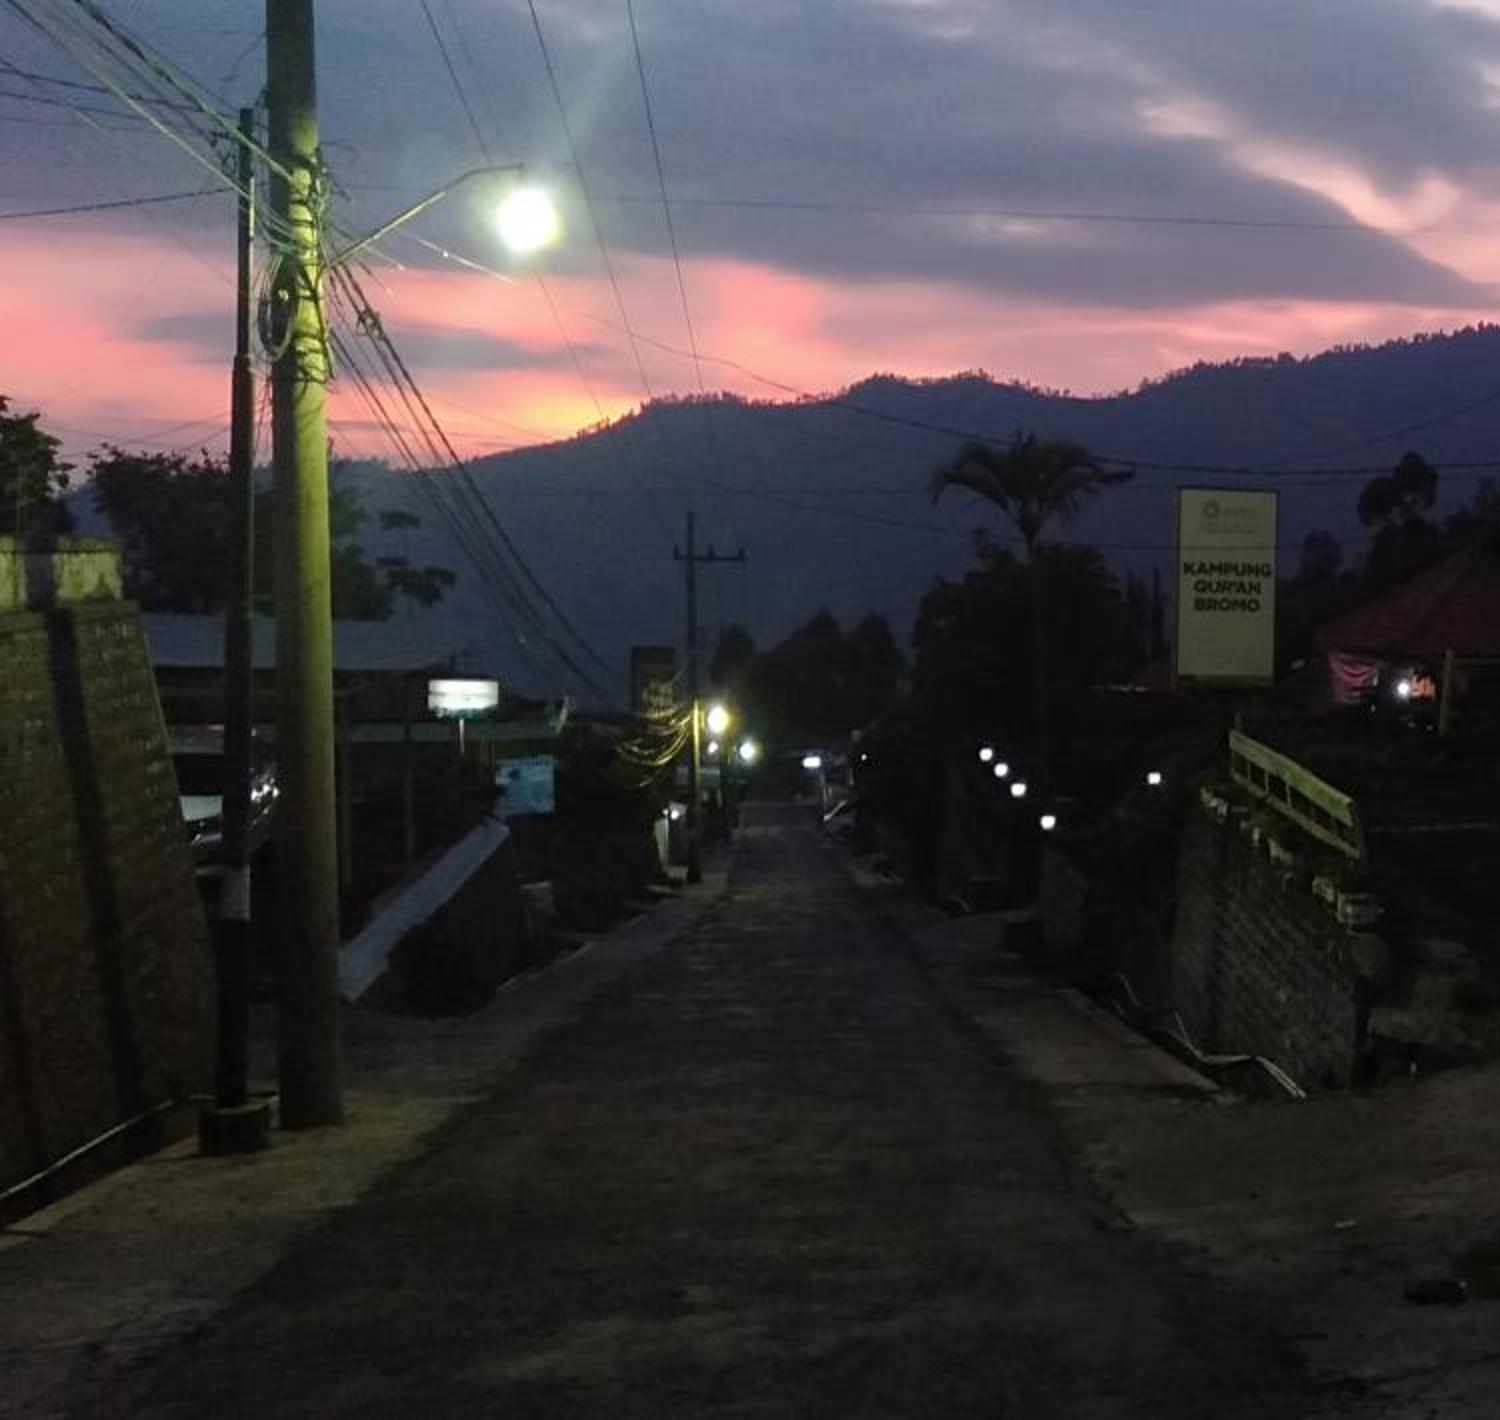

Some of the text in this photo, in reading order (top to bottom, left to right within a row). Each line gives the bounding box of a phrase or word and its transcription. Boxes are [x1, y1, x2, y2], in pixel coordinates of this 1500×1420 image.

[1183, 562, 1271, 577] KAMPUNG
[1194, 580, 1262, 595] QUR'AN
[1194, 597, 1260, 612] BROMO
